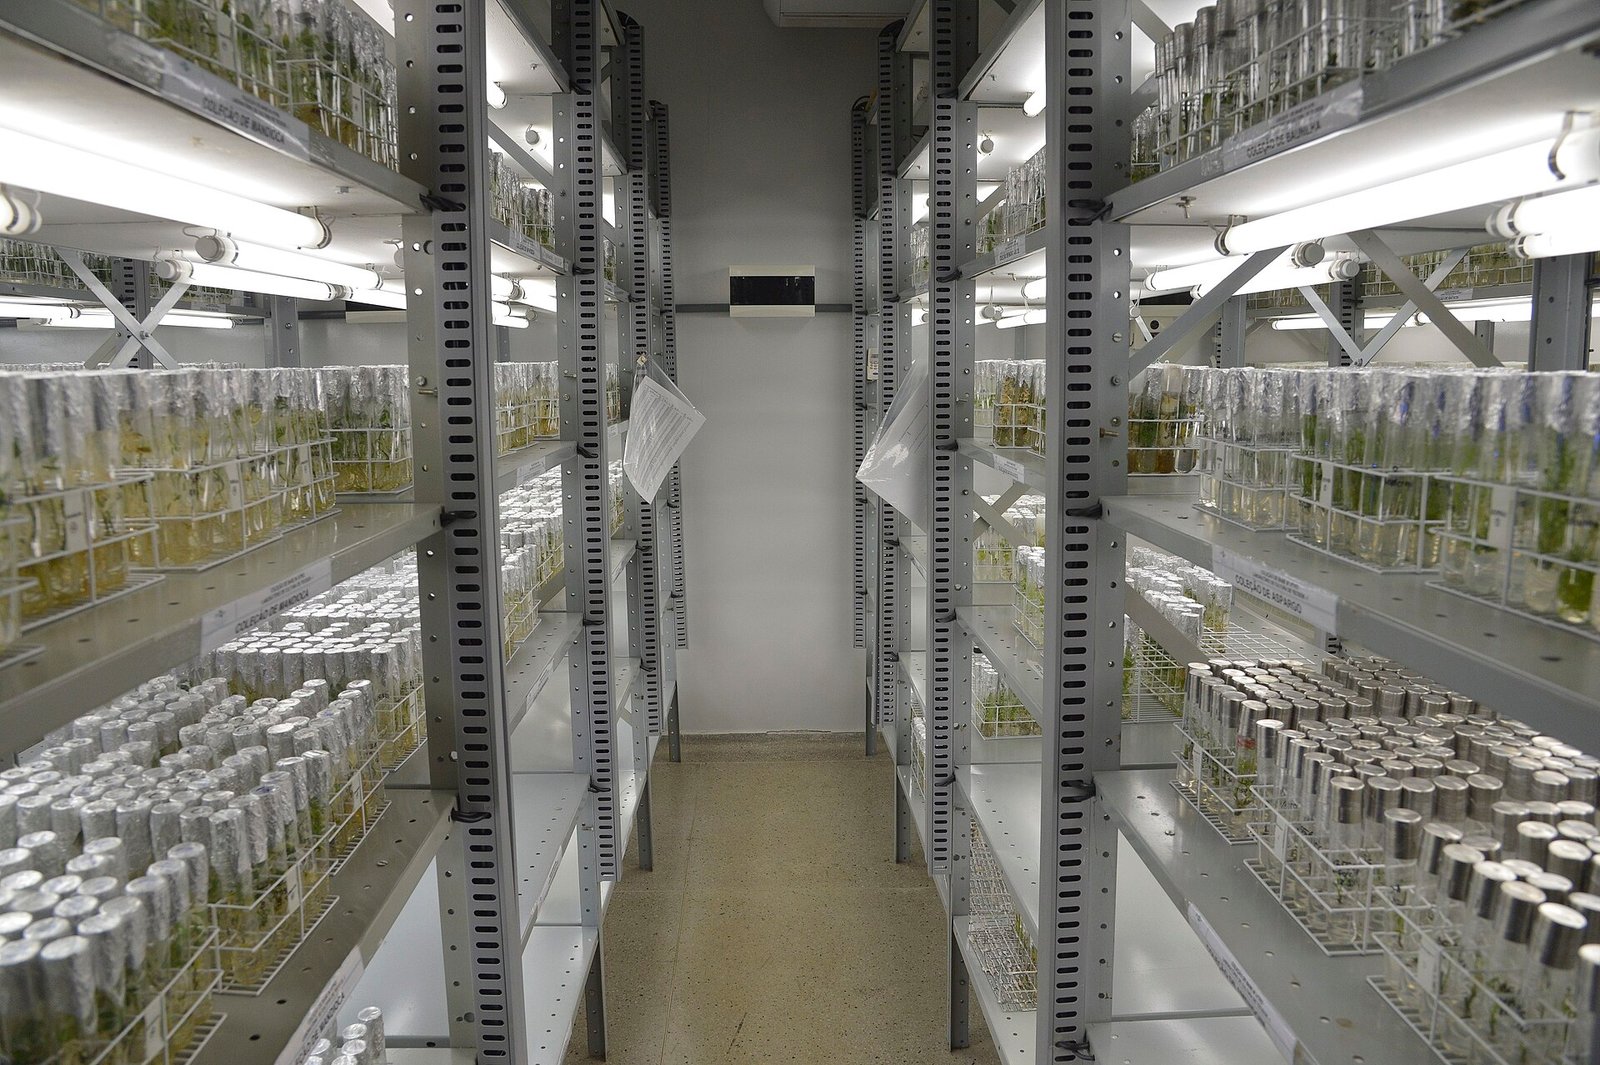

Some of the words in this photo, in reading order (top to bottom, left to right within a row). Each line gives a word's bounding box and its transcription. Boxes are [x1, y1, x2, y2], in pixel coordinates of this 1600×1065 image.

[240, 113, 250, 129] DE
[1247, 136, 1275, 159] COLEÇÃO
[1276, 134, 1285, 147] DE
[1235, 574, 1262, 595] COLEÇÃO
[1262, 586, 1271, 600] DE
[1271, 592, 1302, 614] ASPARGO
[268, 604, 278, 617] DE
